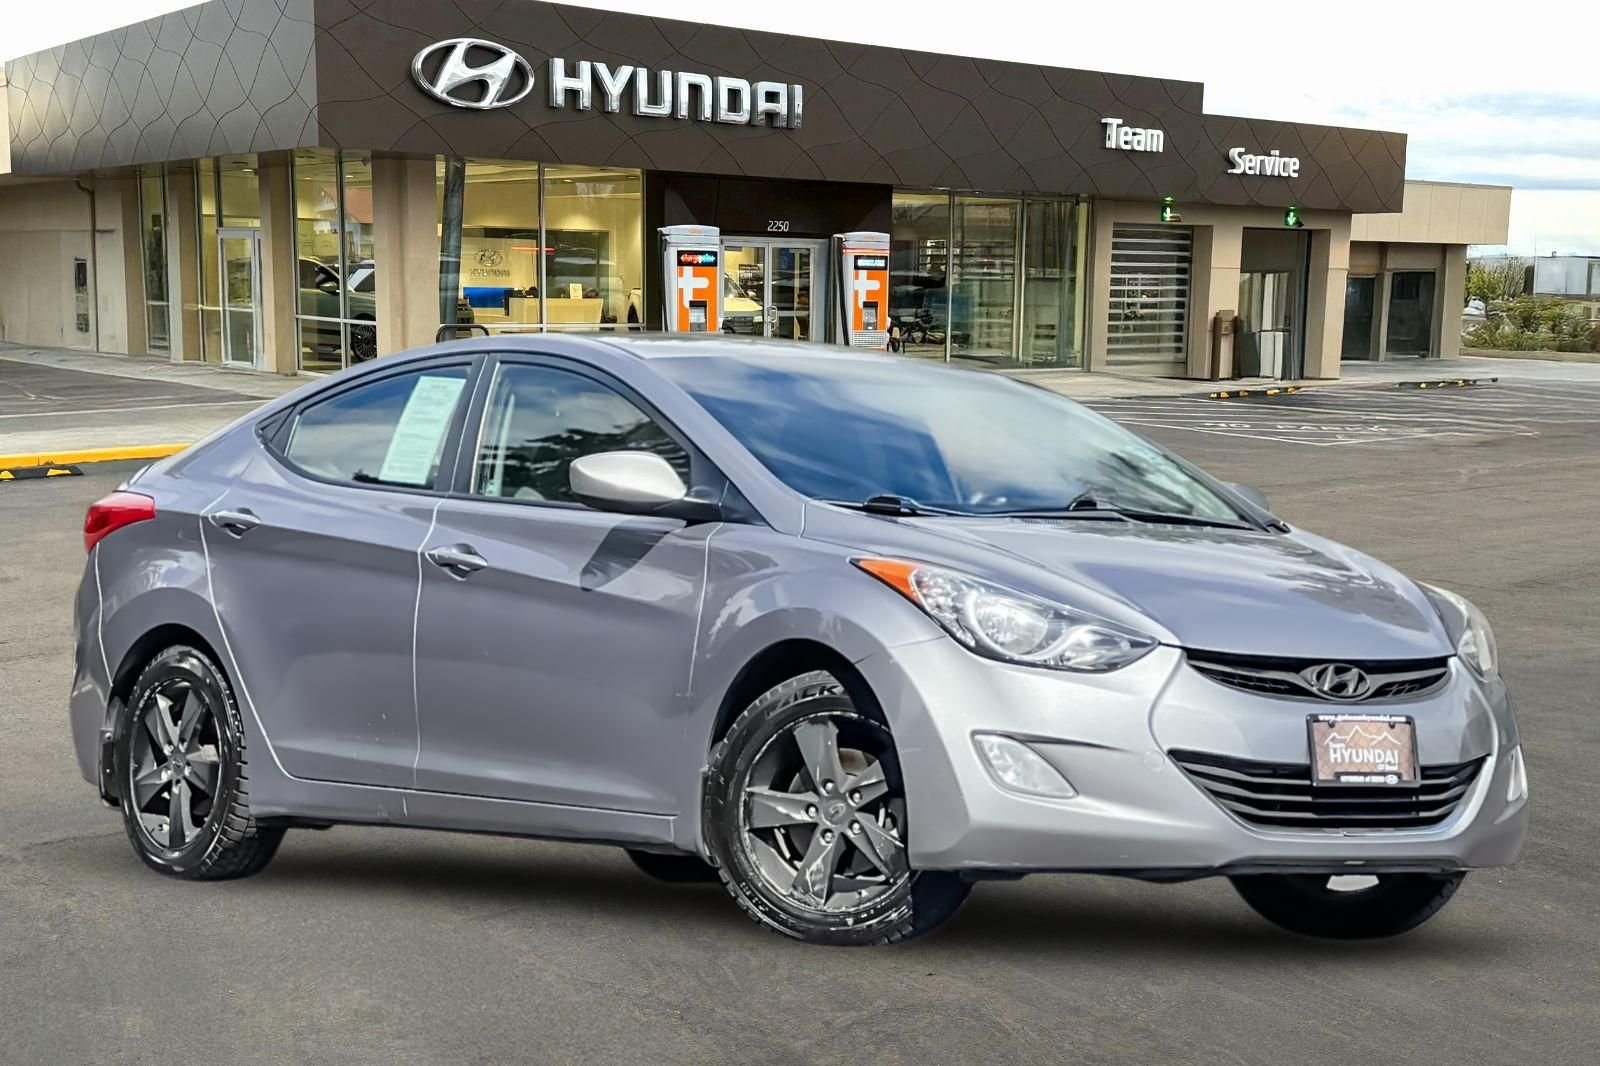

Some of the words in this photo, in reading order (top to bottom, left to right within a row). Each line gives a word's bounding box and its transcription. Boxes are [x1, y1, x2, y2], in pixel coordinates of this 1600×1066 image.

[549, 57, 803, 129] HYUNDAI
[1101, 117, 1164, 153] Team
[1227, 147, 1300, 178] Service
[767, 220, 790, 232] 2250
[1330, 747, 1399, 765] HYUNDAI
